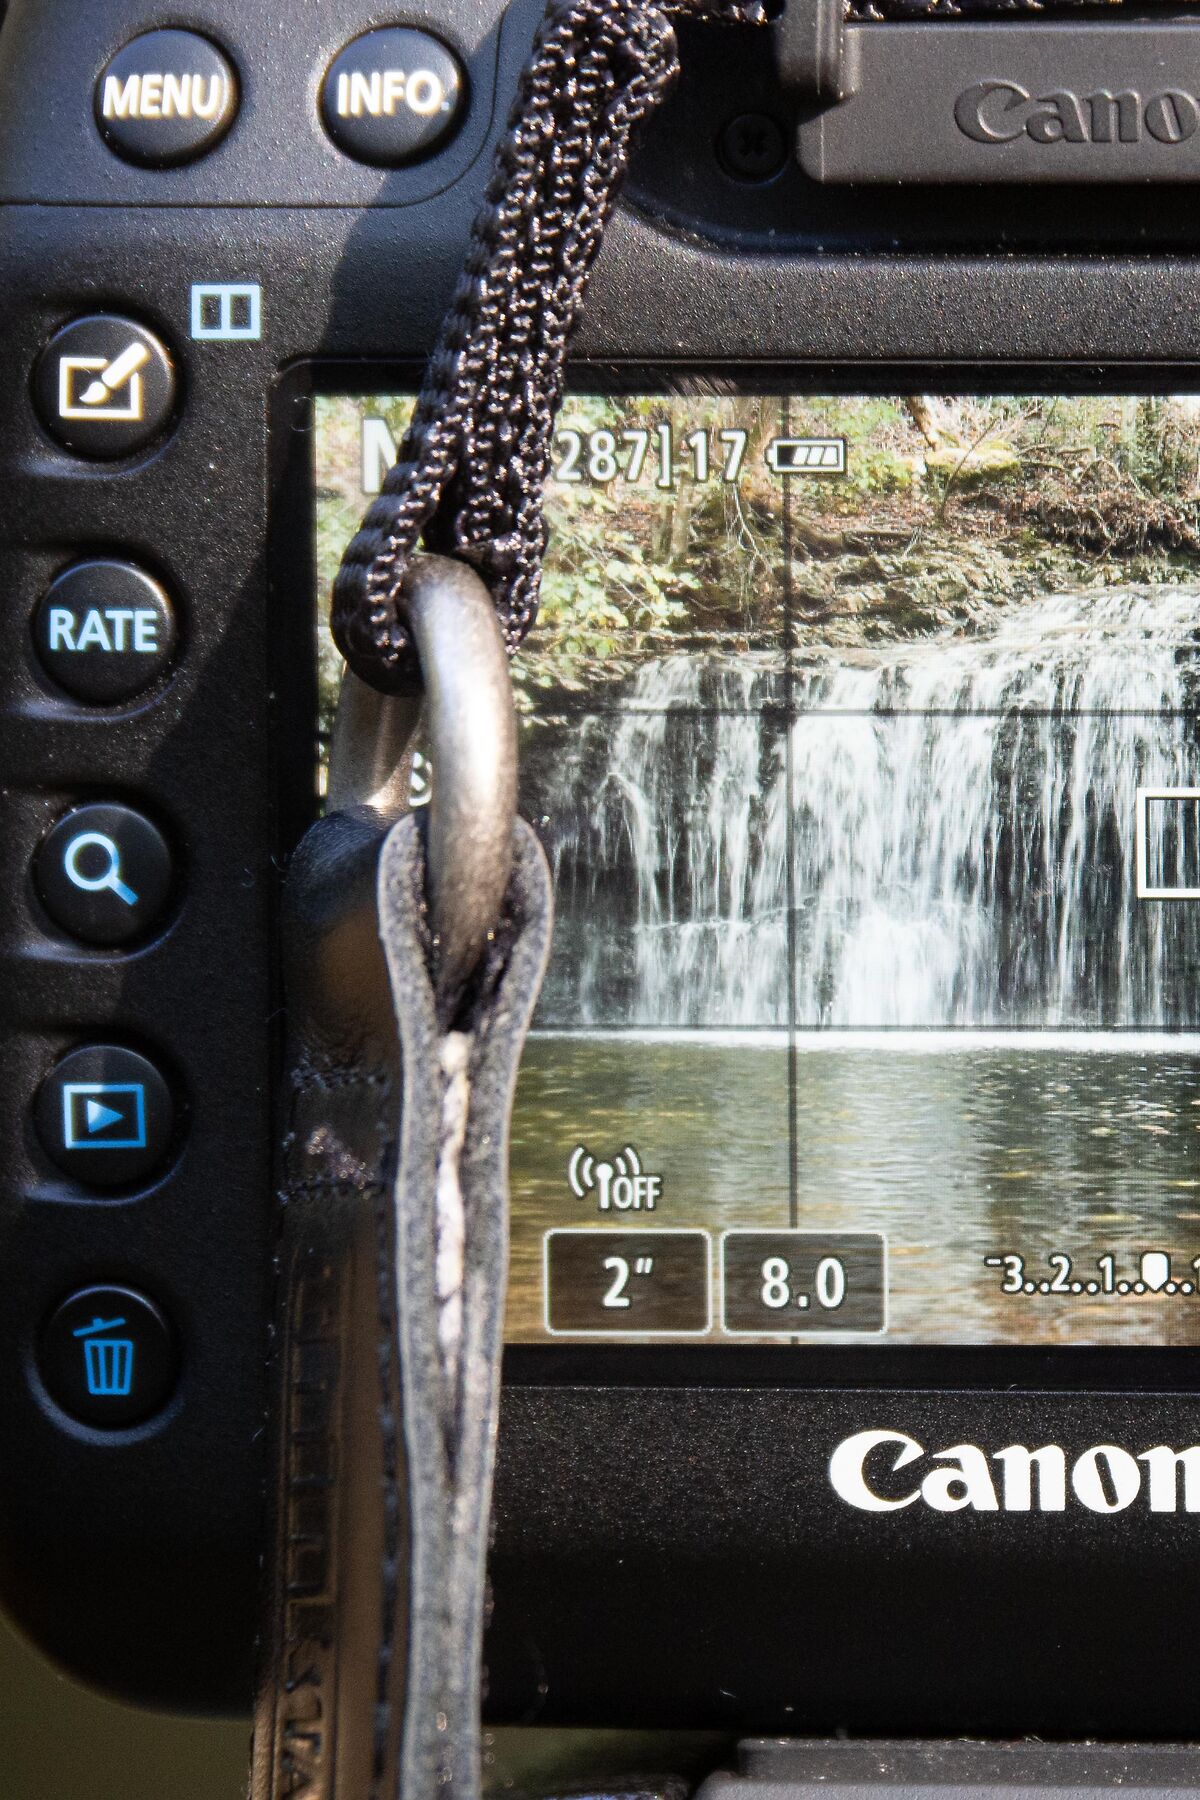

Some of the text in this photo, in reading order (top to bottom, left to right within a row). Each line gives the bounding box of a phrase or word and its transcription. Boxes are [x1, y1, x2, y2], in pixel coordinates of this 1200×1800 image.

[102, 73, 222, 118] MENU
[336, 69, 450, 117] INFO.
[48, 609, 158, 652] RATE
[612, 1176, 662, 1210] OFF
[761, 1257, 846, 1309] 8.0
